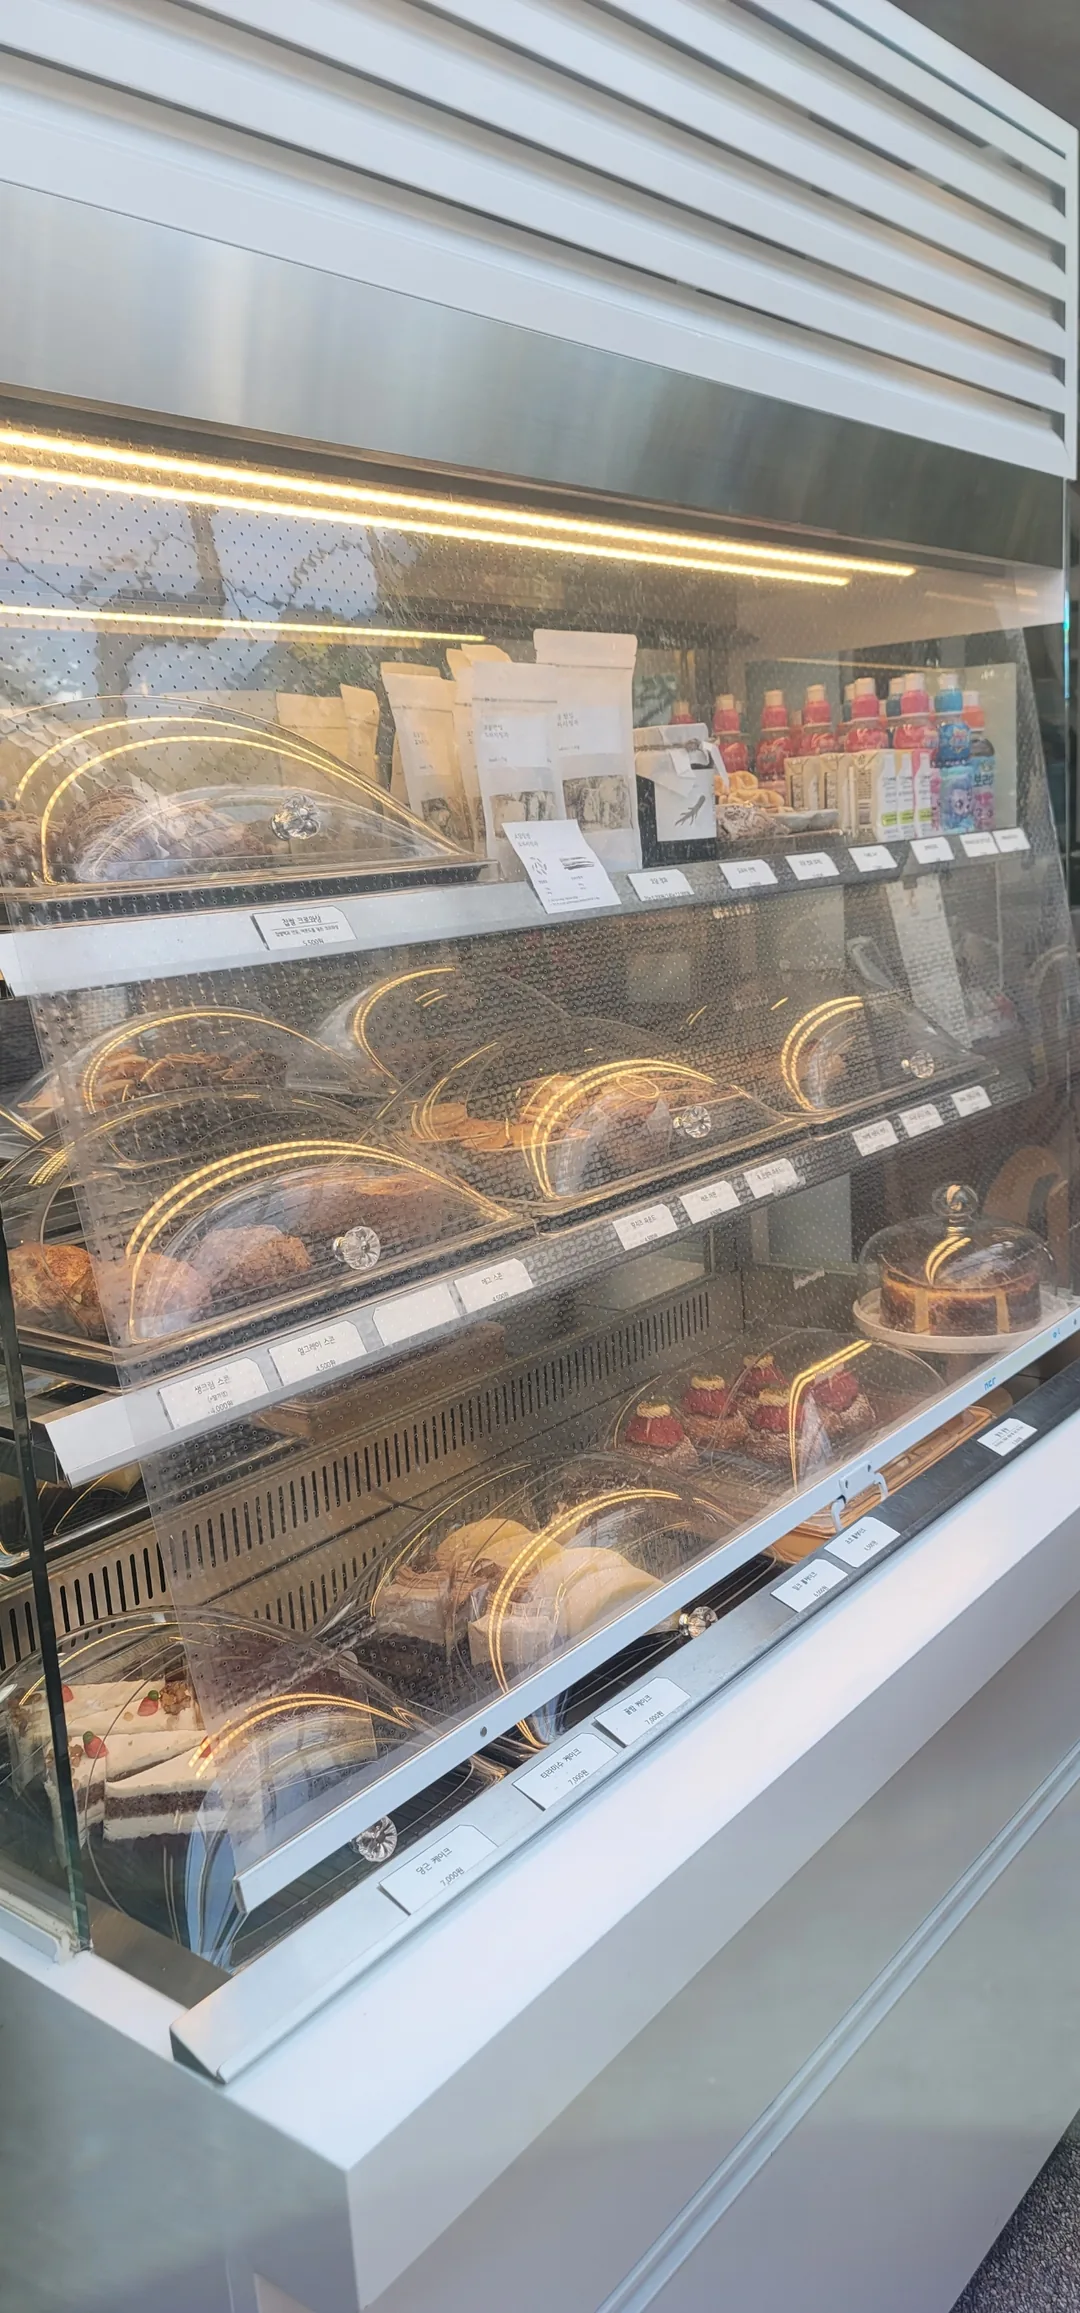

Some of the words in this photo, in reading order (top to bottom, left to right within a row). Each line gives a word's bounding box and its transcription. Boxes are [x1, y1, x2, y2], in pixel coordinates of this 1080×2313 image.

[282, 918, 296, 927] 찹쌀
[297, 915, 322, 924] 크로와상
[298, 1341, 322, 1356] 얼그레이
[324, 1336, 336, 1345] 스콘
[316, 1360, 336, 1372] 4,500원
[194, 1381, 216, 1395] 생크림
[217, 1375, 231, 1386] 스콘
[635, 1695, 652, 1708] 케이크
[644, 1710, 664, 1725] 7,000원
[541, 1761, 564, 1779] 티라미수
[564, 1748, 582, 1763] 케이크
[568, 1769, 589, 1785] 7,000원
[416, 1862, 432, 1875] 당근
[432, 1847, 452, 1862] 케이크
[440, 1867, 465, 1886] 7,000원
